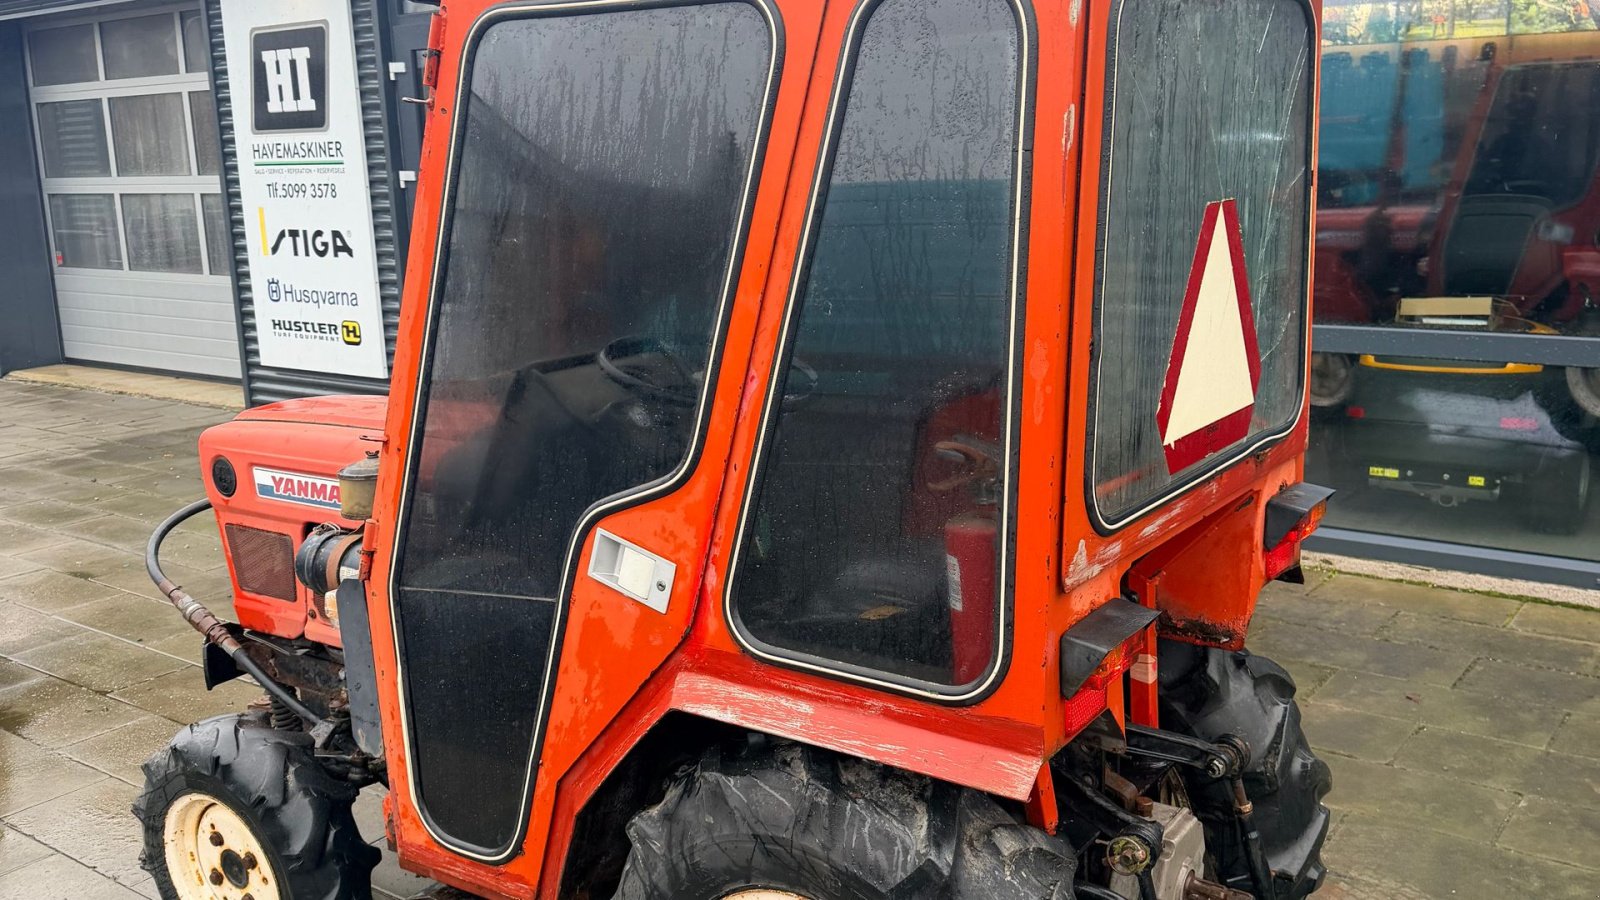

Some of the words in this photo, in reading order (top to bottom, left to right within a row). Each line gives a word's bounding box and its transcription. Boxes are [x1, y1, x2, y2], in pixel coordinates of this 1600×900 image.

[261, 47, 316, 113] HI
[252, 141, 344, 159] HAVEMASKINER
[266, 182, 307, 198] Tlf.5099
[310, 183, 337, 198] 3578
[271, 229, 354, 258] STIGA
[283, 284, 359, 309] Husqvarna
[271, 319, 339, 335] HUSTLER
[294, 333, 340, 342] EQUIPMENT
[271, 475, 342, 503] YANMA
